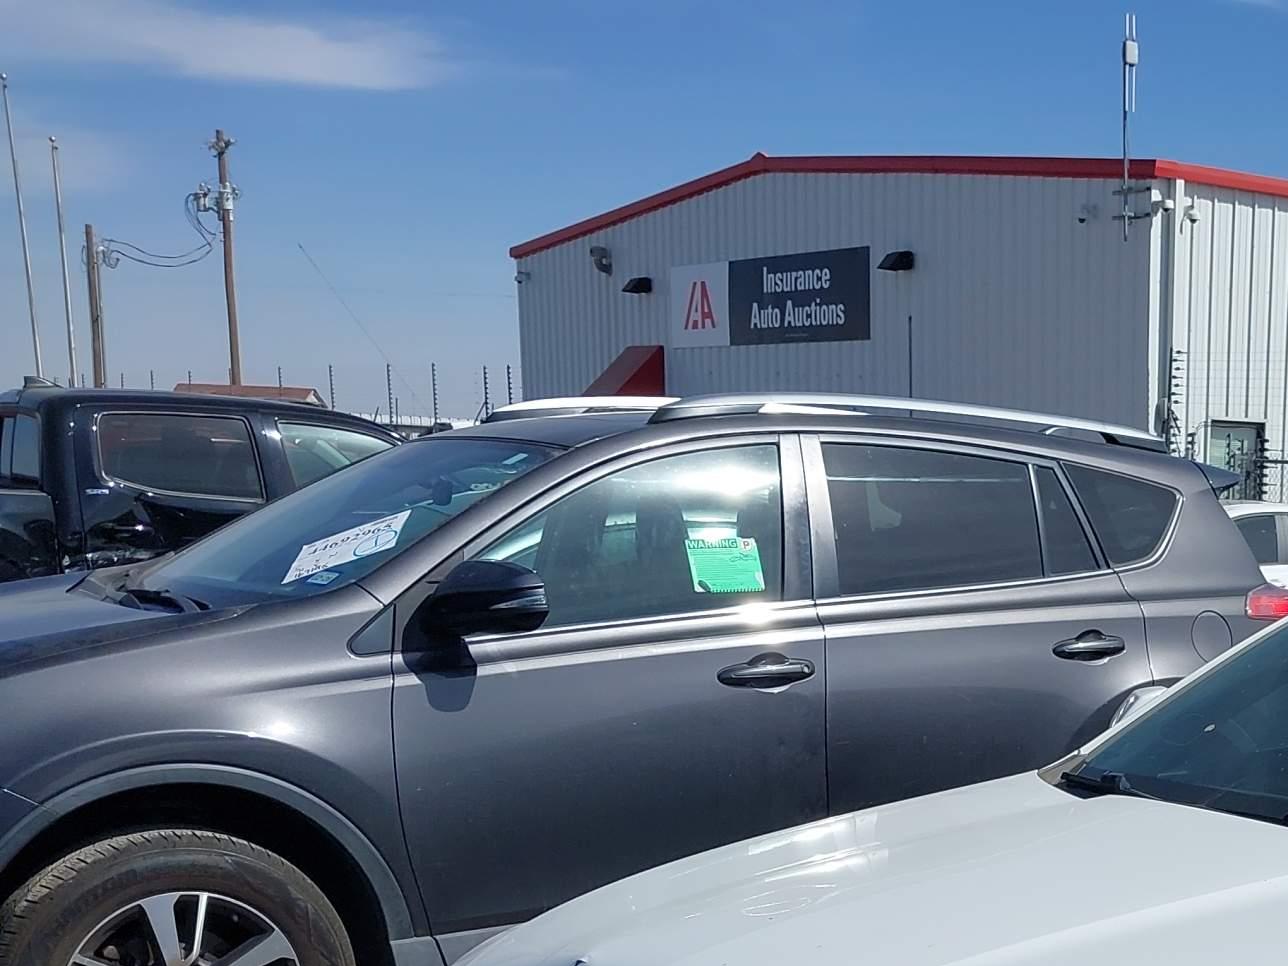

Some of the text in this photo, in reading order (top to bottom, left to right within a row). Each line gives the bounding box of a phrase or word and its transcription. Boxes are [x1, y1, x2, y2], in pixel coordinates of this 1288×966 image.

[763, 266, 831, 293] Insurance
[750, 298, 845, 329] Auto Auctions
[687, 539, 737, 549] WARNING
